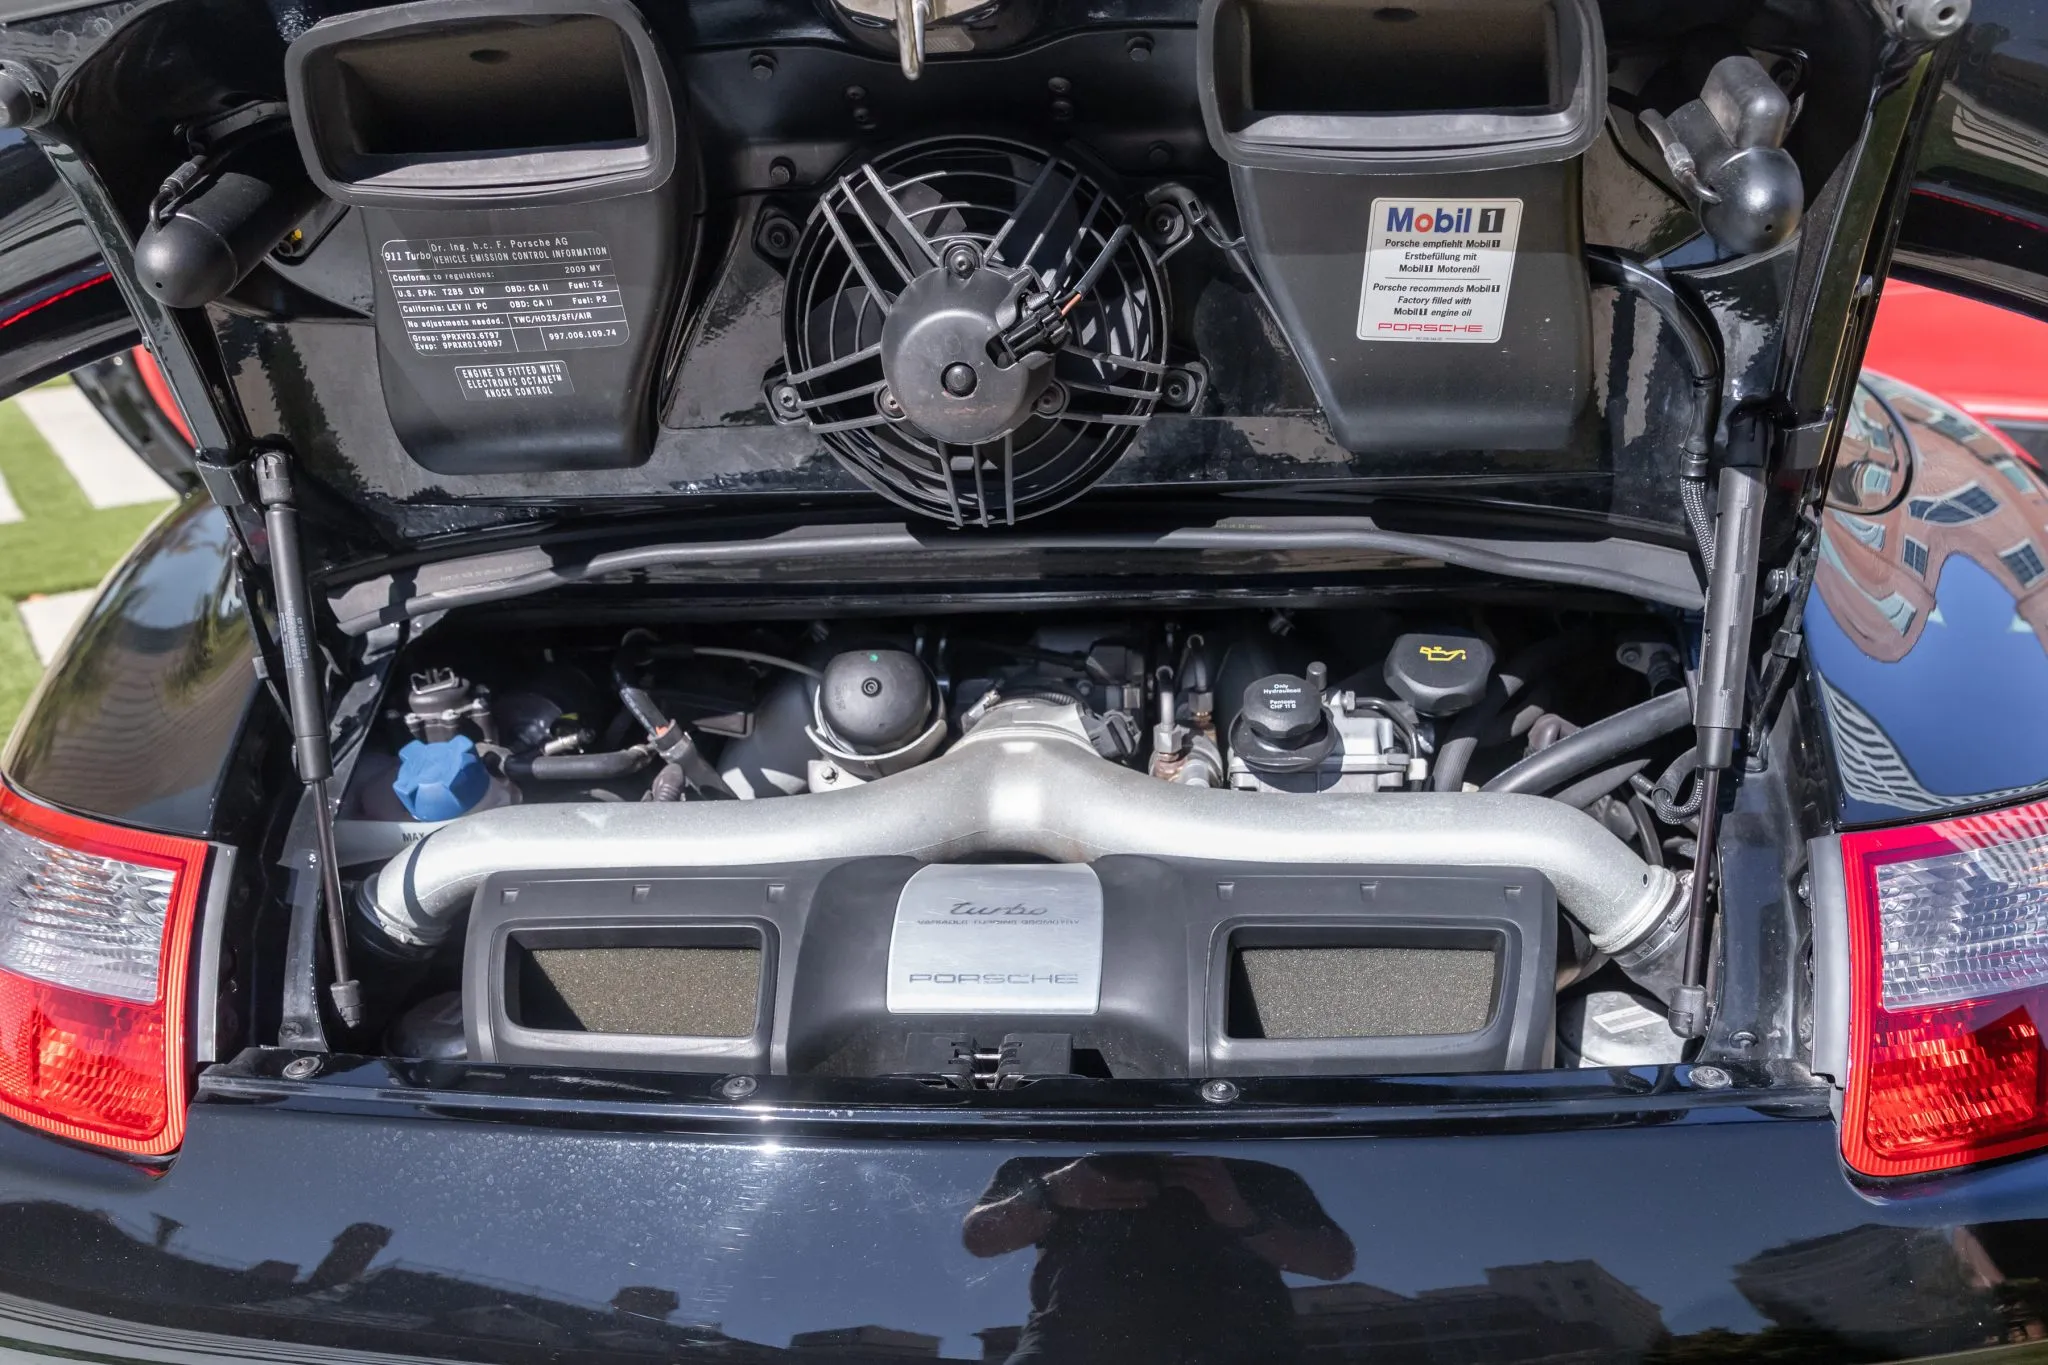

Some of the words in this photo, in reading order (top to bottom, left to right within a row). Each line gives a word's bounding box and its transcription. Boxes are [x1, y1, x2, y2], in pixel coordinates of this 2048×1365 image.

[1386, 207, 1472, 234] Mobil
[430, 244, 446, 252] Dr.
[450, 243, 469, 252] Ing.
[473, 242, 493, 250] h.c.
[496, 240, 506, 249] F.
[510, 239, 550, 248] Porsche
[555, 237, 568, 246] AG
[1384, 239, 1420, 248] Porsche
[1422, 240, 1463, 249] empfiehlt
[384, 252, 402, 261] 911
[405, 251, 431, 260] Turbo
[434, 255, 468, 264] VEHICLE
[470, 252, 509, 263] EMISSION
[512, 250, 550, 261] CONTROL
[552, 246, 608, 258] INFORMATION
[1404, 252, 1460, 262] Erstbefüllung
[565, 266, 586, 274] 2009
[589, 264, 601, 272] MY
[1437, 265, 1480, 273] Motorenöl
[392, 274, 431, 282] Conforms
[445, 272, 495, 281] regulations:
[505, 285, 526, 293] OBD:
[528, 284, 540, 292] CA
[568, 282, 590, 290] Fuel:
[592, 280, 604, 288] T2
[1372, 283, 1408, 292] Porsche
[1409, 284, 1464, 293] recommends
[397, 290, 415, 298] U.S.
[417, 289, 437, 297] EPA:
[442, 288, 464, 296] T2B5
[469, 286, 485, 295] LDV
[509, 300, 530, 308] OBD:
[572, 297, 594, 305] Fuel:
[596, 295, 608, 303] P2
[1397, 296, 1429, 306] Factory
[1432, 297, 1453, 305] filled
[1455, 297, 1472, 305] with
[402, 304, 445, 313] California:
[446, 303, 462, 312] LEV
[476, 302, 488, 310] PC
[1430, 310, 1459, 318] engine
[1462, 309, 1472, 317] oil
[407, 320, 418, 328] No
[422, 319, 469, 329] adjustments
[472, 317, 504, 326] needed.
[1378, 322, 1484, 333] PORSCHE
[412, 334, 439, 342] Group:
[548, 329, 617, 340] 997.006.109.74
[415, 342, 437, 350] Evap:
[462, 368, 494, 379] ENGINE
[496, 367, 505, 377] IS
[507, 365, 537, 376] FITTED
[540, 364, 561, 374] WITH
[466, 377, 518, 389] ELECTRONIC
[484, 388, 512, 398] KNOCK
[515, 385, 553, 396] CONTROL
[402, 832, 425, 842] MAX
[950, 902, 1048, 916] turbo
[909, 973, 1080, 984] PORSCHE
